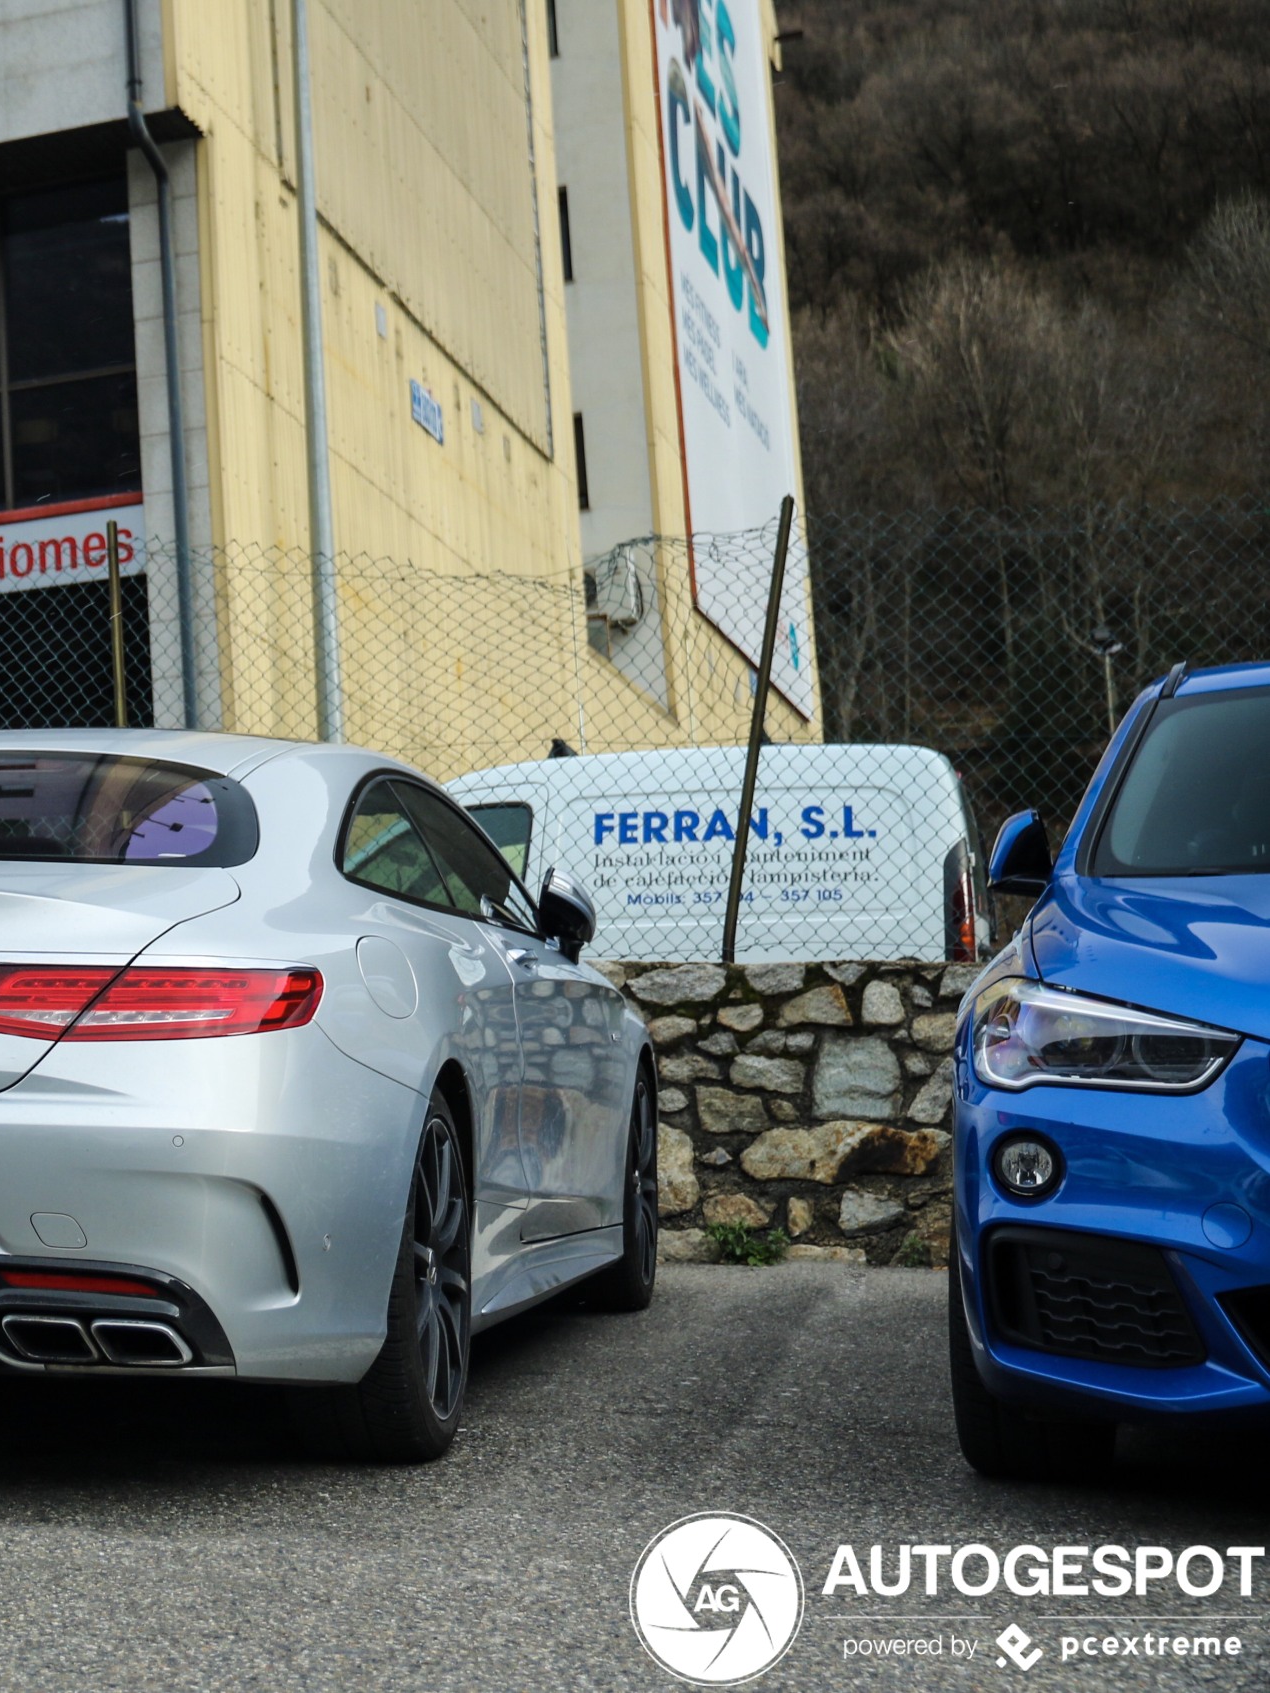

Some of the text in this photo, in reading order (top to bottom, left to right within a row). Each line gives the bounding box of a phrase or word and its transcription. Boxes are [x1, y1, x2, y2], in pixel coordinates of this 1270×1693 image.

[668, 56, 770, 350] CLUB
[594, 805, 877, 847] FERRAN, S.L.
[746, 848, 871, 864] anteniment
[593, 873, 617, 888] de
[625, 868, 729, 888] calefacció
[693, 891, 722, 904] 357
[781, 889, 809, 901] 357
[817, 888, 842, 901] 105
